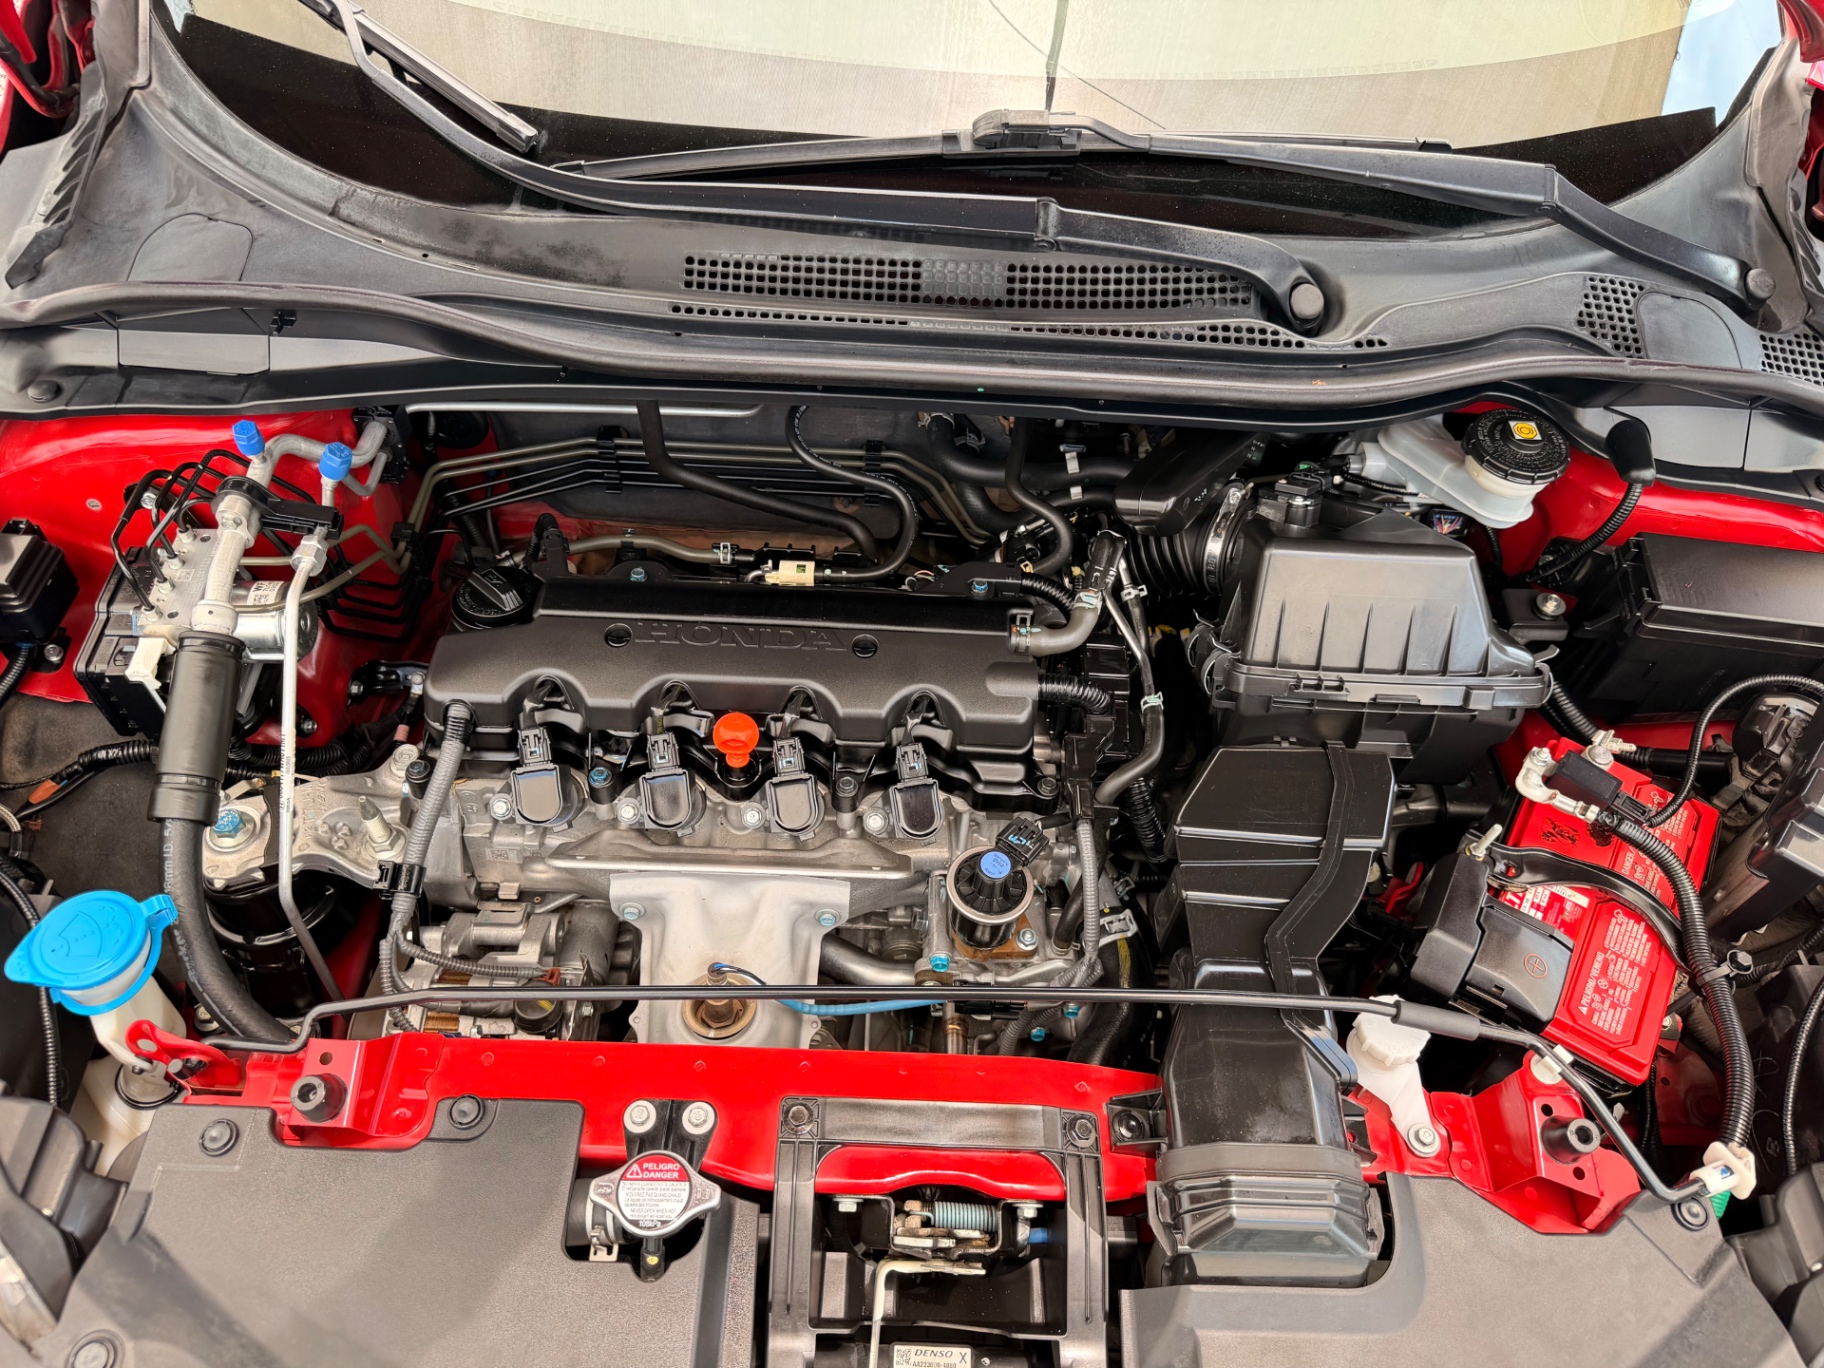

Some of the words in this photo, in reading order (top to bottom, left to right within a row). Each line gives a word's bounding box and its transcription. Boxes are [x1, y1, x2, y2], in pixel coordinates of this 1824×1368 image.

[635, 621, 848, 651] HONDA
[1582, 950, 1604, 1006] PELIGRO/VENENO
[643, 1163, 680, 1171] PELIGRO
[643, 1171, 679, 1179] DANGER
[914, 1349, 953, 1358] DENSO
[959, 1351, 967, 1364] X
